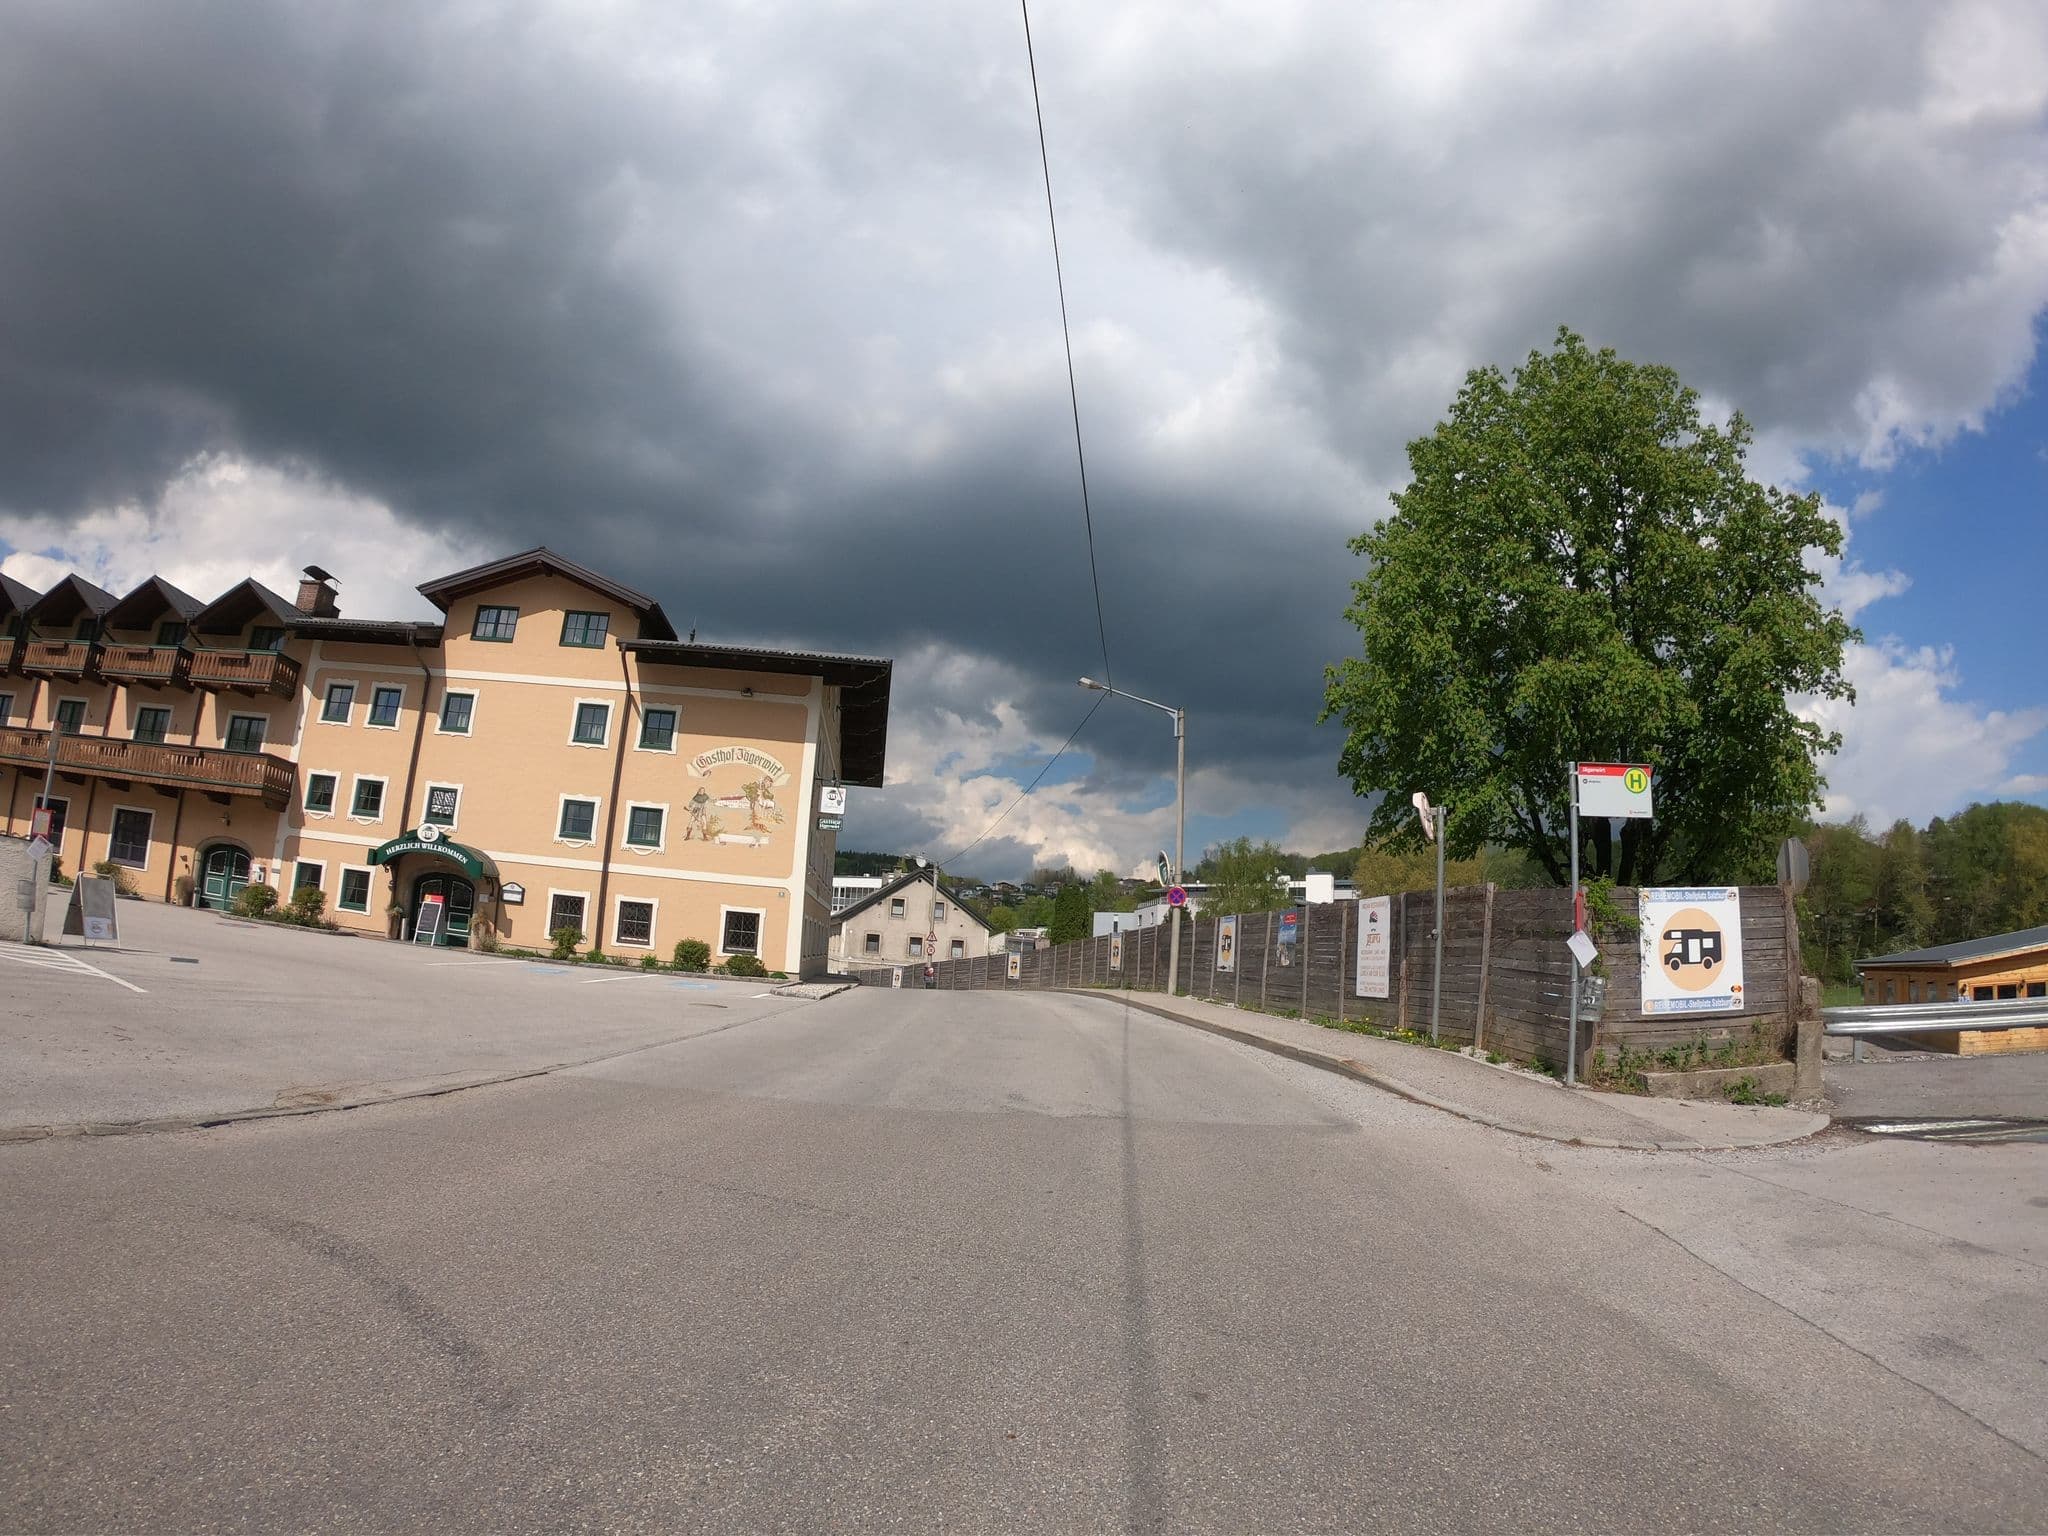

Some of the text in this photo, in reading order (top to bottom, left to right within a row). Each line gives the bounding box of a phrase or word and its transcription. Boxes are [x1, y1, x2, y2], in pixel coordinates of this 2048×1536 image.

[695, 747, 783, 777] Gasthof Jägerwirt
[1630, 773, 1642, 789] H
[385, 842, 469, 865] HERZLICH WILLKOMMEN
[1711, 998, 1733, 1008] Salzburg
